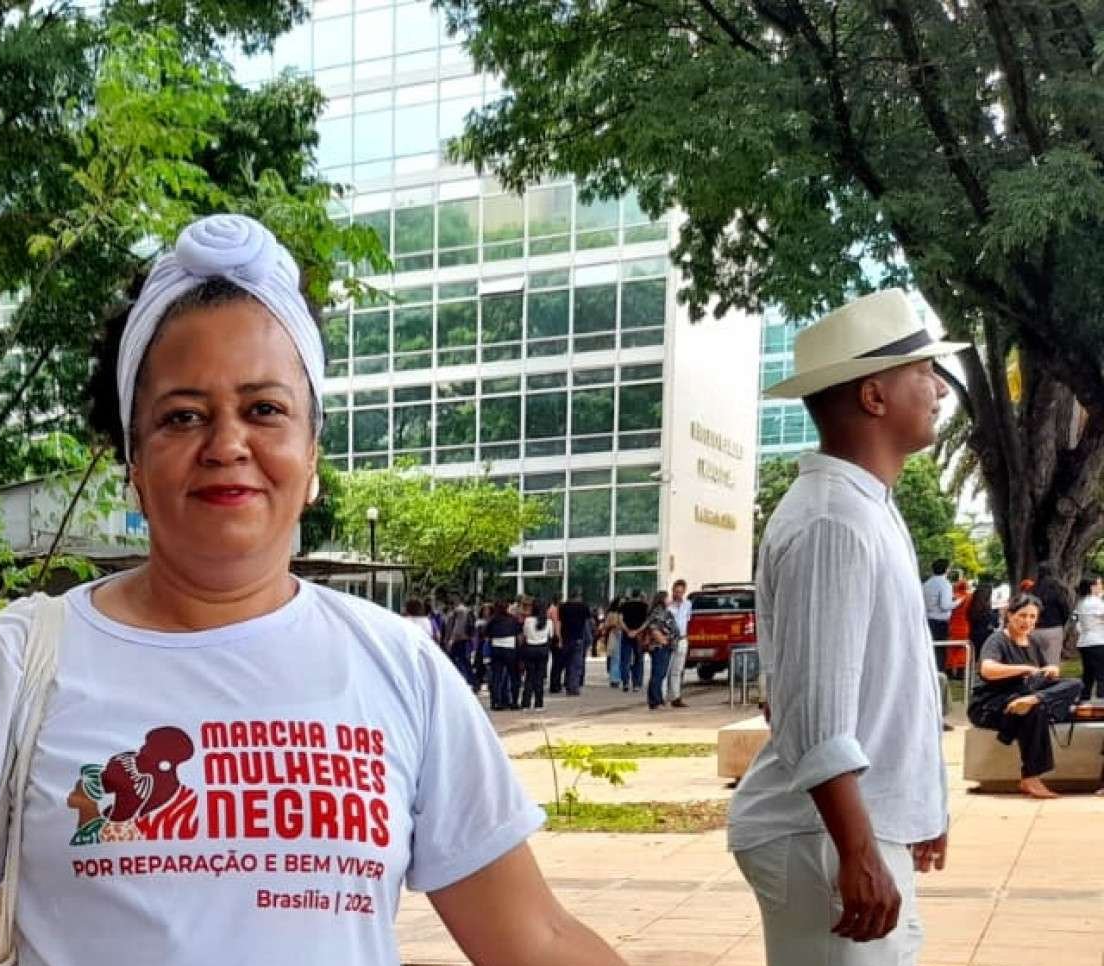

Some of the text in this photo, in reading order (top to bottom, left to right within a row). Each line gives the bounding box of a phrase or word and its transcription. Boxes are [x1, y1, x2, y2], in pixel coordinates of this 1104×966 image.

[200, 720, 385, 756] MARCHA DAS
[203, 751, 386, 795] MULHERES
[206, 788, 390, 848] NEGRAS
[71, 849, 385, 882] POR REPARAÇÃO E BEM VIVER
[256, 889, 330, 910] Brasília
[344, 892, 375, 914] 202
